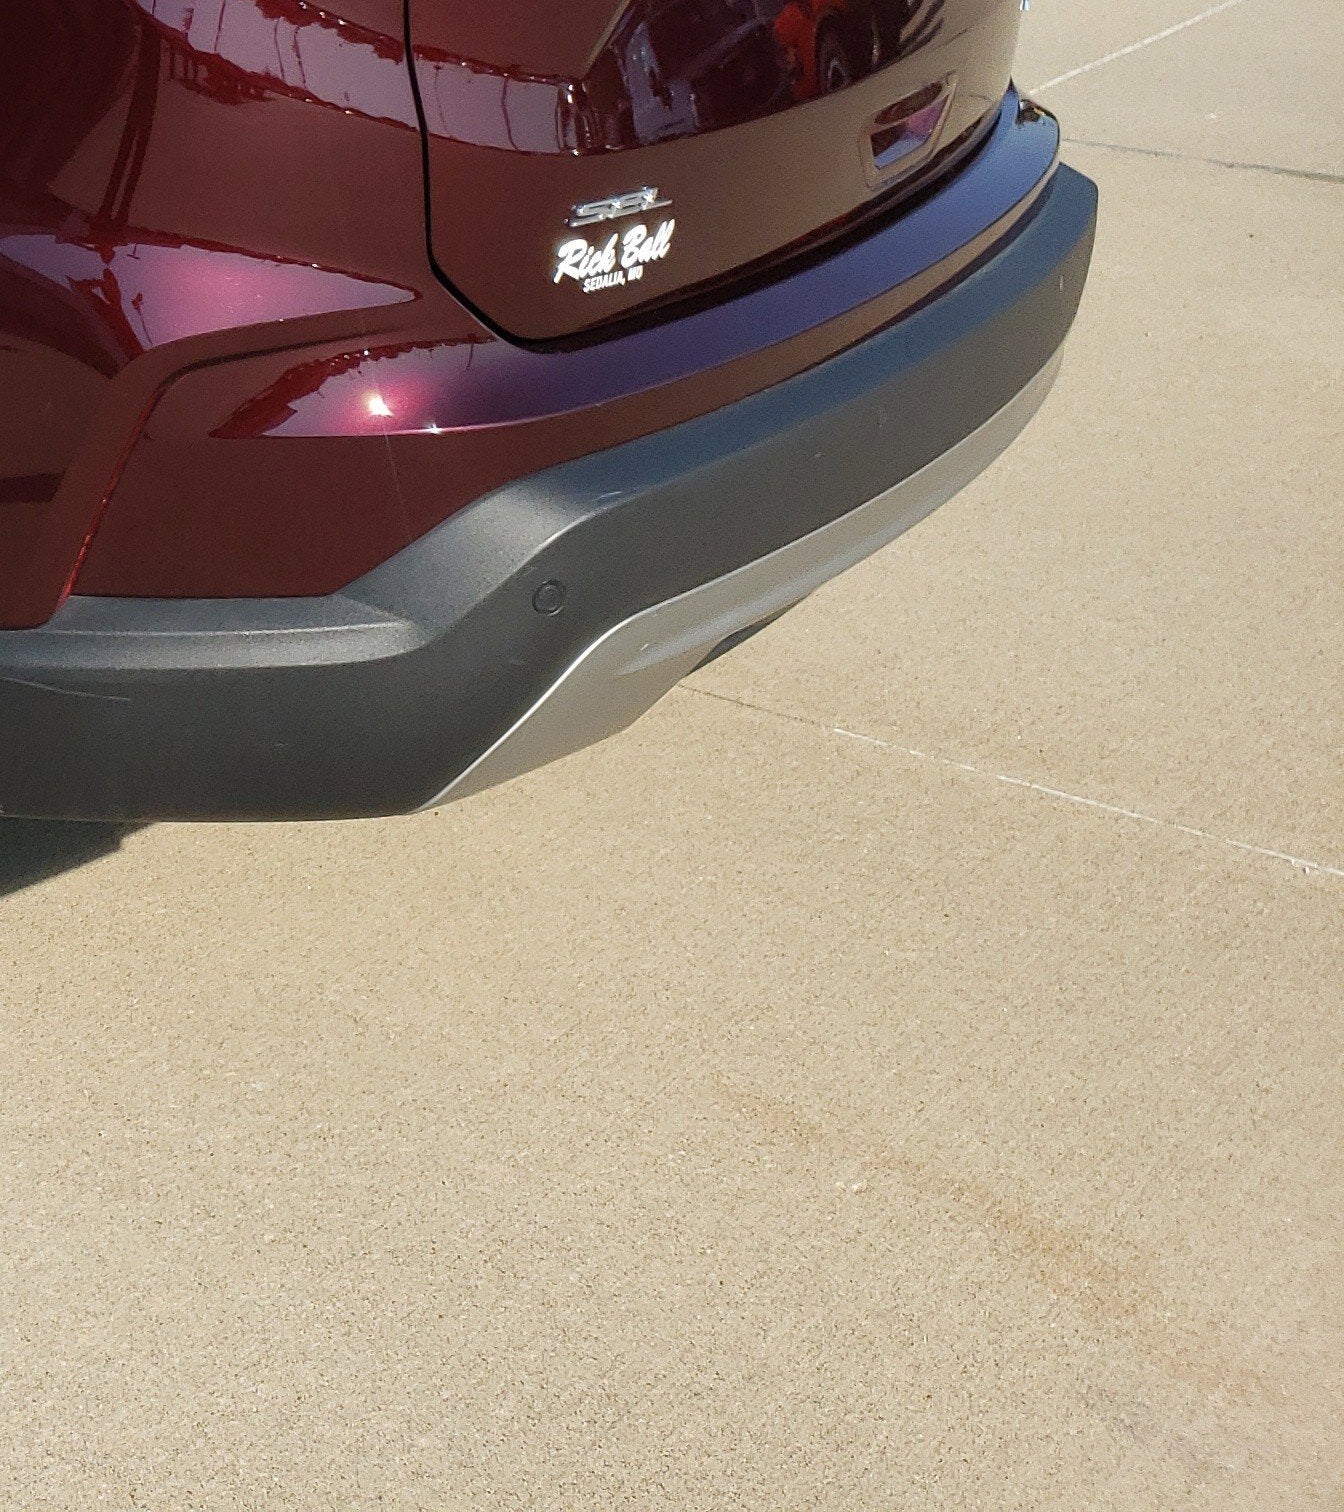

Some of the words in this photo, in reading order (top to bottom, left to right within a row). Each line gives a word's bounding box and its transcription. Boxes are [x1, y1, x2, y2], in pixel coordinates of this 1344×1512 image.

[552, 233, 619, 285] Rick
[620, 218, 676, 269] Ball
[627, 265, 644, 283] MO
